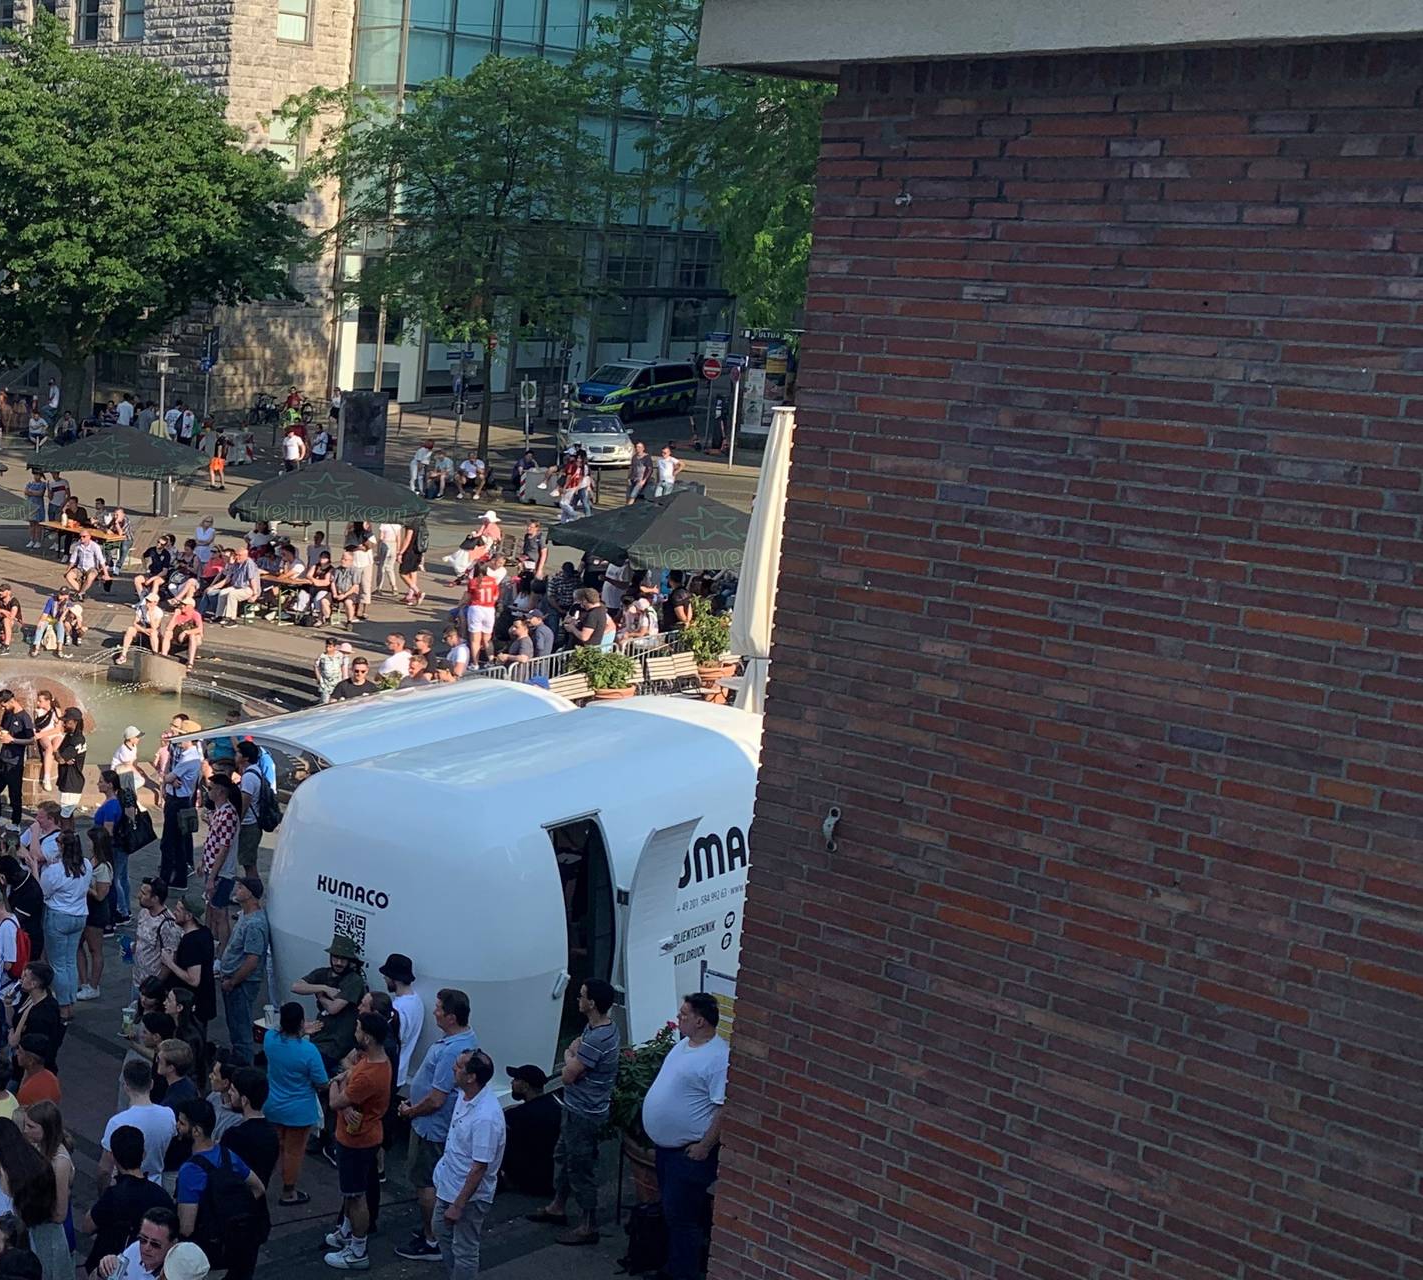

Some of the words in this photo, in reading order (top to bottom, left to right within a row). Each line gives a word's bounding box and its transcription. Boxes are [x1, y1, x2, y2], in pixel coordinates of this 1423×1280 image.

[241, 500, 408, 522] Heineken
[480, 587, 492, 602] 11
[317, 874, 389, 909] KUMACO
